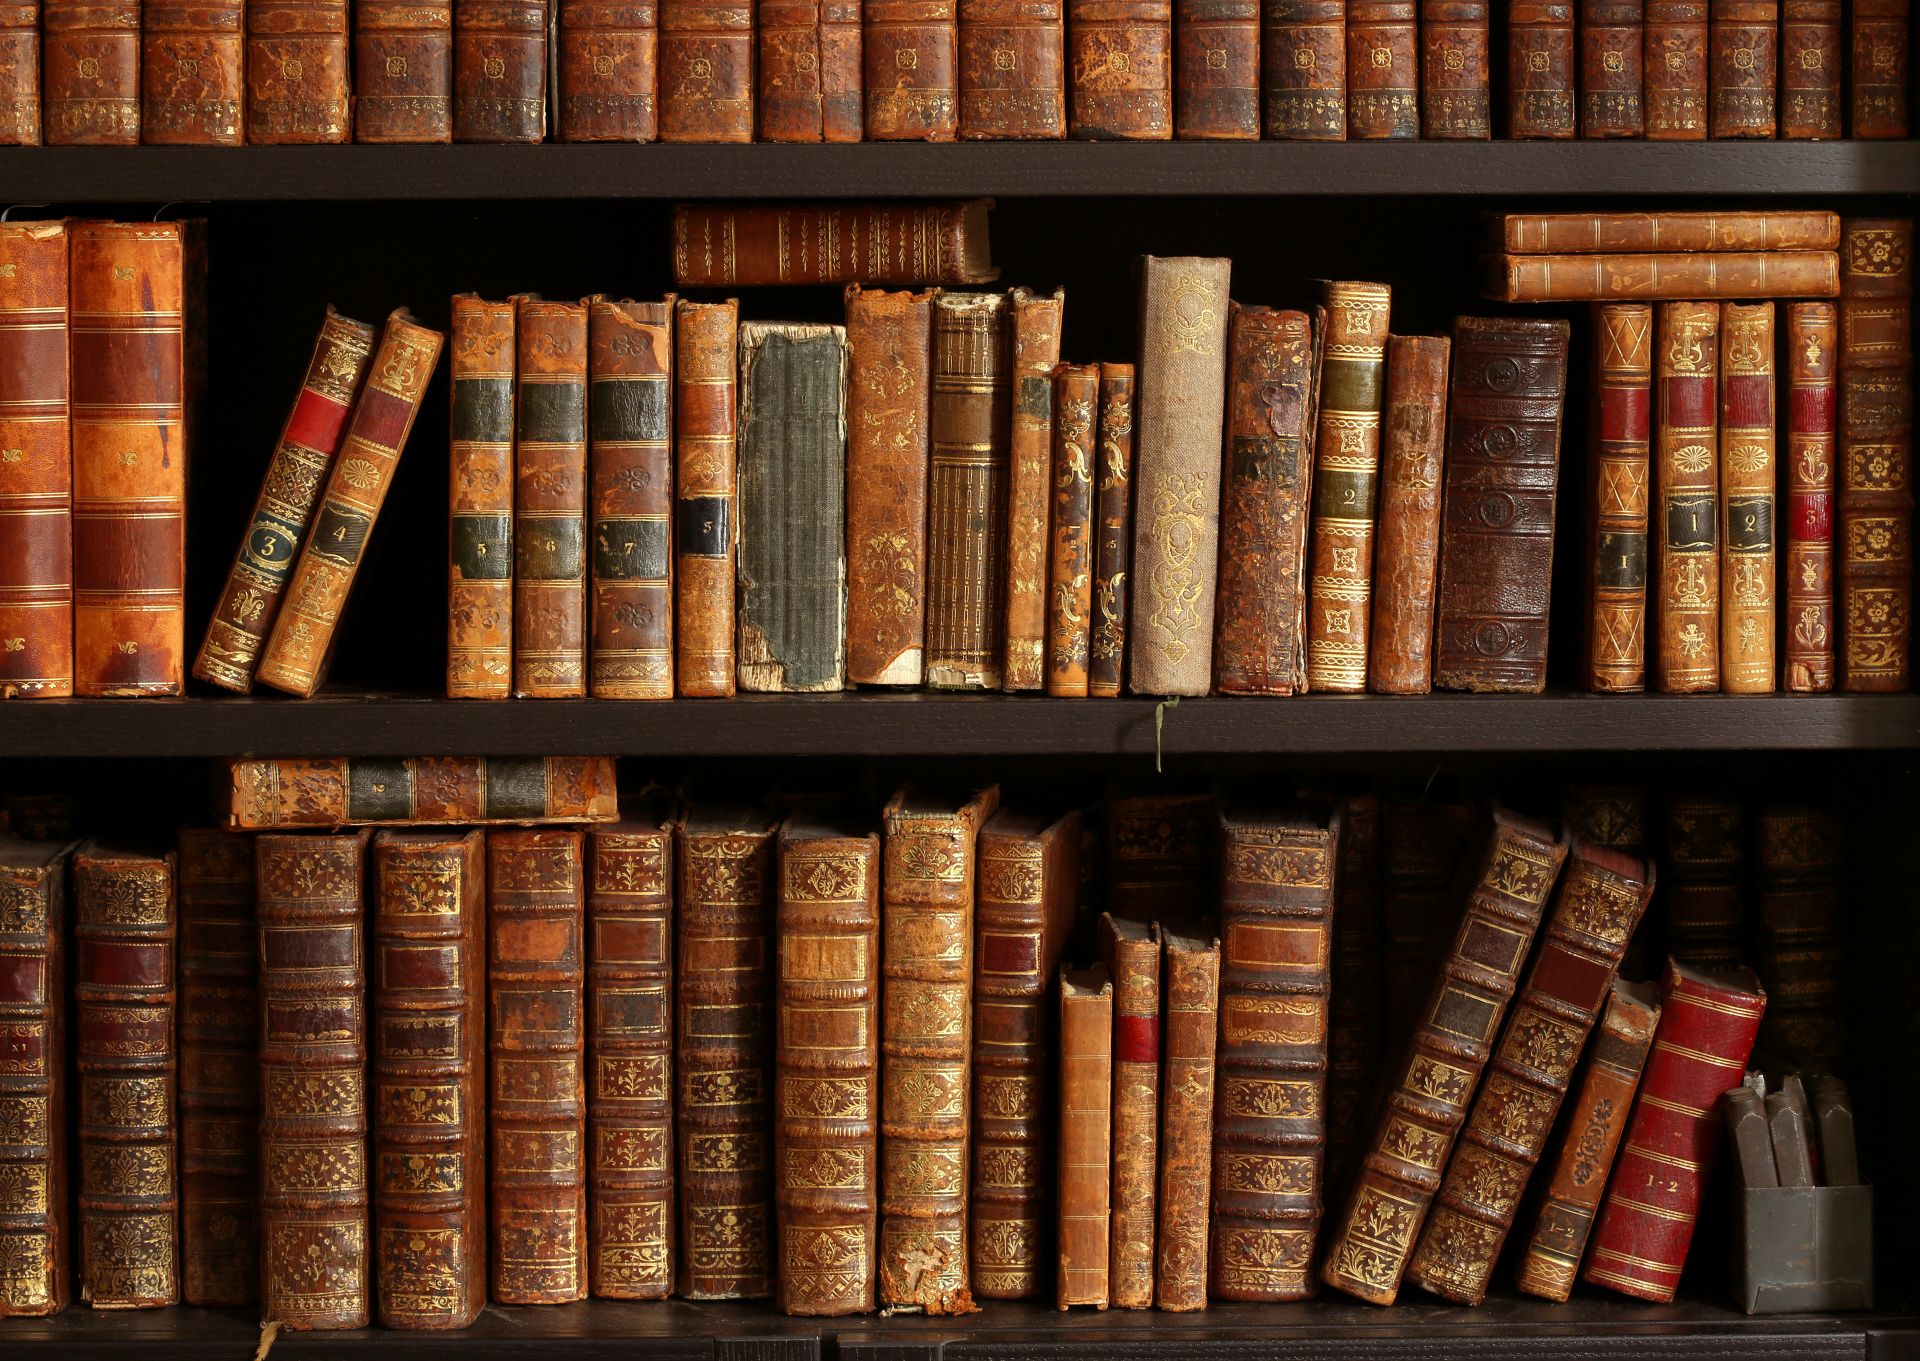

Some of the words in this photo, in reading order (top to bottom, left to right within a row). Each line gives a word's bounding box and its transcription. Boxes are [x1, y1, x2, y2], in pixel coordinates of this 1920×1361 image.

[1343, 488, 1356, 505] 2
[703, 521, 713, 534] 5
[1692, 512, 1698, 532] 1
[1744, 514, 1756, 532] 2
[333, 525, 347, 542] 4
[261, 536, 277, 556] 3
[478, 543, 487, 555] 5
[546, 540, 556, 553] 6
[624, 541, 634, 555] 7
[1070, 539, 1077, 549] 2
[373, 783, 385, 793] 2
